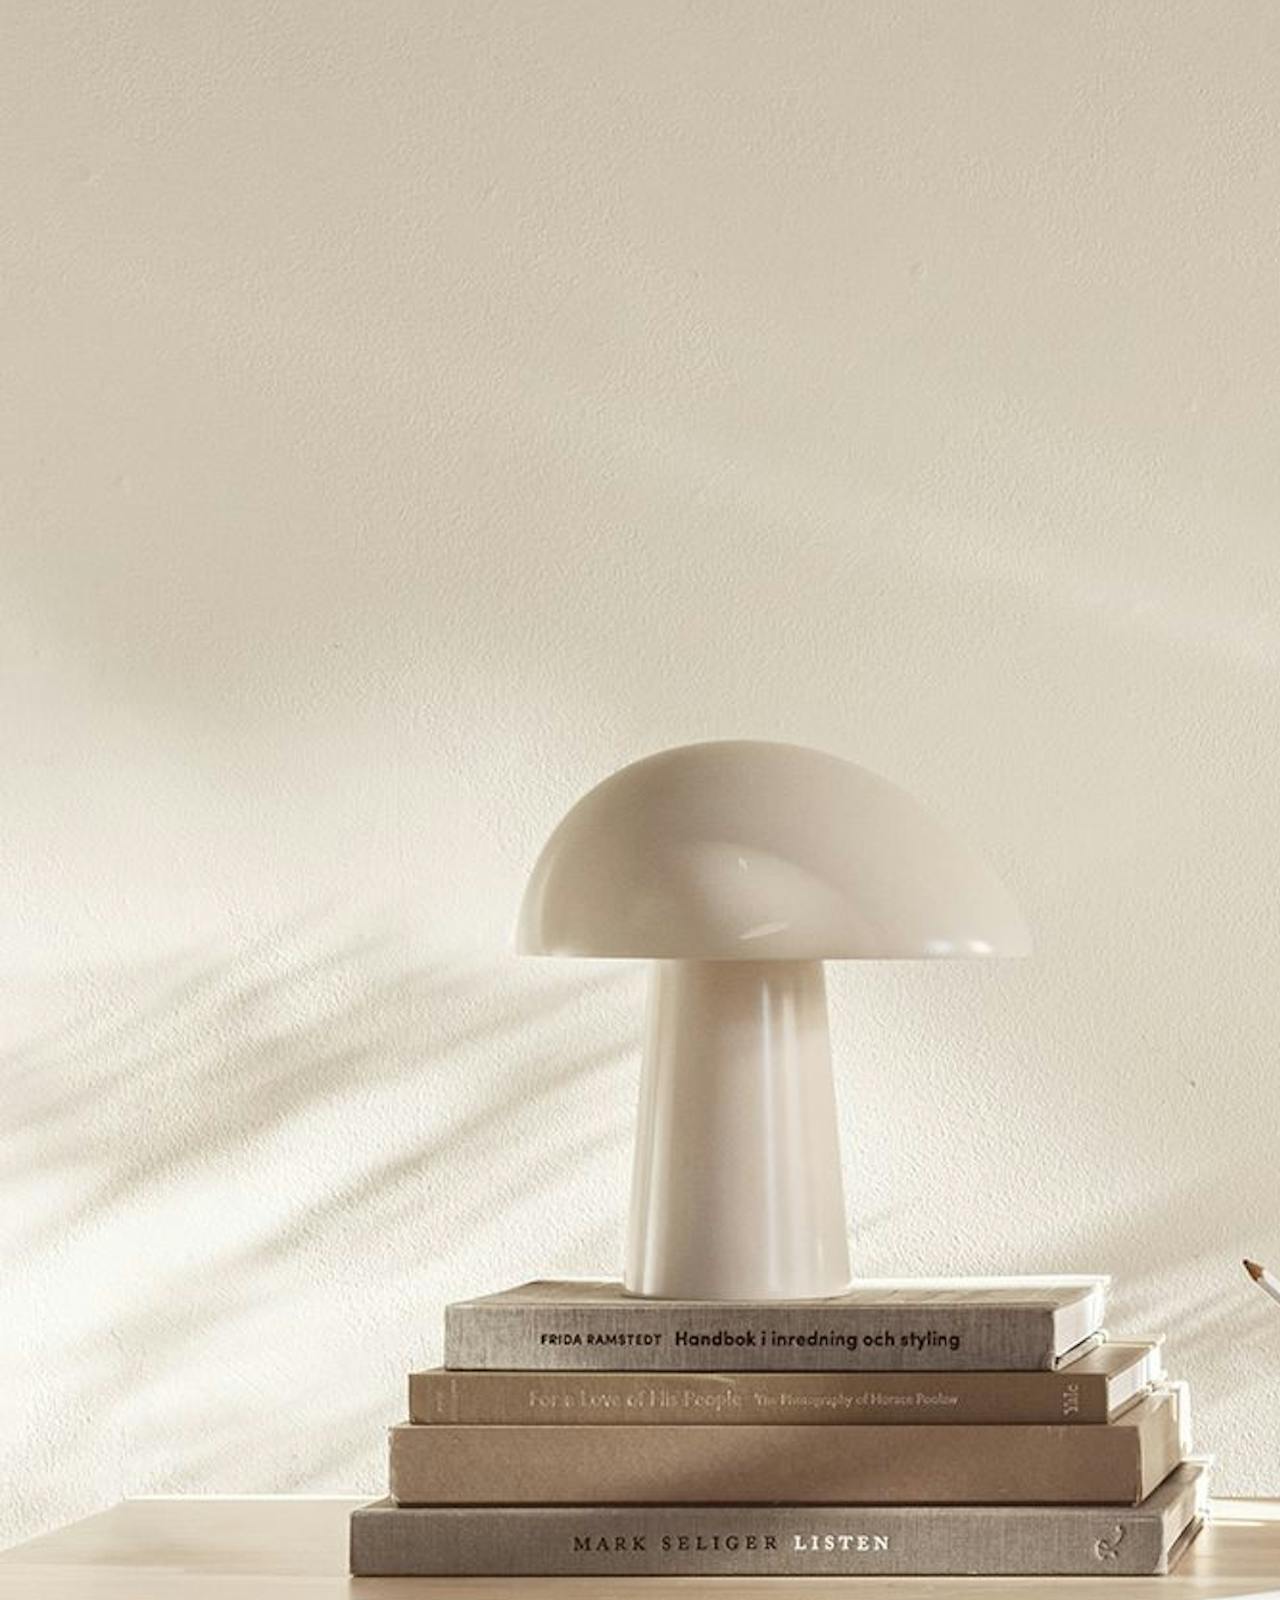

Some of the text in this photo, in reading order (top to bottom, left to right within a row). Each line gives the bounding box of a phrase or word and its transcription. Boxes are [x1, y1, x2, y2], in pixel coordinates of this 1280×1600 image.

[540, 1330, 961, 1352] FRIDA RAMSTEDT Handbok i inredning och styling
[529, 1390, 557, 1408] For
[580, 1389, 622, 1408] Love
[626, 1389, 647, 1408] of
[683, 1390, 742, 1412] People
[573, 1534, 889, 1552] MARK SELIGER LISTEN
